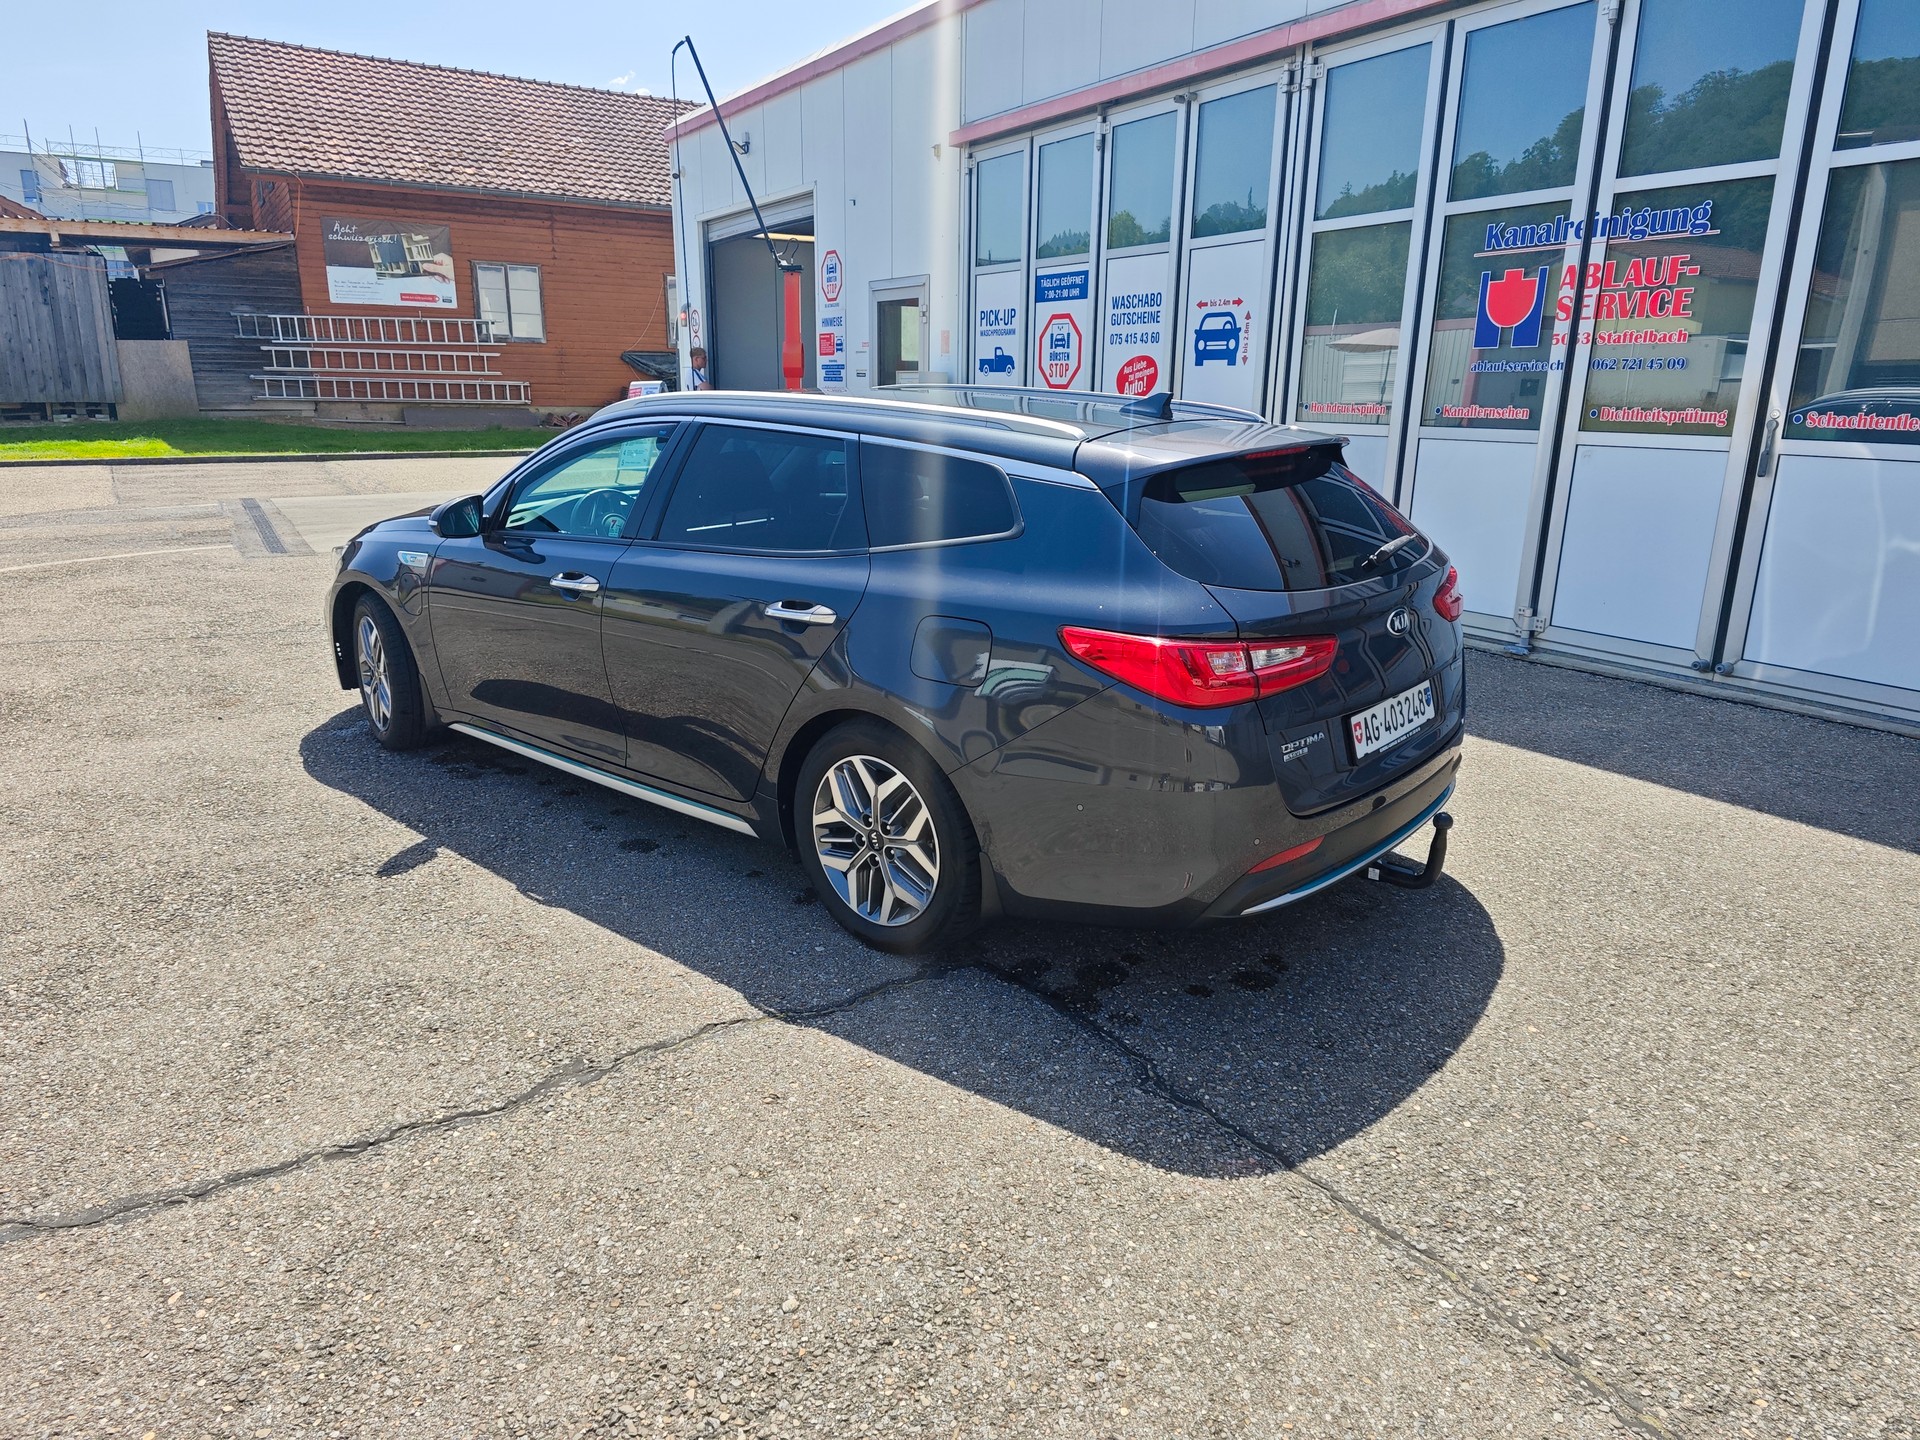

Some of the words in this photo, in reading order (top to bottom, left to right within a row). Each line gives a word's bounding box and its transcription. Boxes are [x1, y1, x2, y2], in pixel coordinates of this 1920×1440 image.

[333, 220, 358, 233] Ächt
[1485, 200, 1713, 250] Kanalreinigung
[1560, 254, 1700, 290] ABLAUF-
[826, 283, 837, 294] STOP
[1040, 277, 1060, 287] TÄGLICH
[1060, 275, 1085, 286] GEÖFFNET
[1044, 289, 1068, 299] 7:00-21:00
[1069, 288, 1080, 297] UHR
[1111, 292, 1162, 310] WASCHABO
[1209, 299, 1218, 307] bis
[1555, 288, 1694, 322] SERVICE
[821, 316, 843, 328] HINWEISE
[980, 308, 1016, 327] PICK-UP
[1111, 311, 1161, 326] GUTSCHEINE
[980, 328, 1016, 337] WASCHPROGRAMM
[1110, 333, 1123, 345] 075
[1124, 332, 1138, 345] 415
[1139, 332, 1149, 344] 43
[1150, 332, 1160, 344] 60
[1596, 328, 1689, 345] Staffelbach
[1049, 350, 1070, 362] BÜRSTEN
[1049, 363, 1070, 378] STOP
[1123, 366, 1133, 375] Aus
[1133, 360, 1147, 371] Liebe
[1591, 358, 1617, 371] 062
[1621, 358, 1643, 371] 721
[1646, 358, 1663, 370] 45
[1667, 357, 1687, 370] 09
[1135, 367, 1155, 379] meinem
[1123, 376, 1147, 395] Auto!
[1310, 402, 1386, 417] Hochdruckspülen
[1442, 404, 1530, 420] Kanalfernsehen
[1599, 406, 1728, 427] Dichtheitsprüfung
[1805, 410, 1920, 432] Schachtentle
[1392, 612, 1409, 631] KIA
[1281, 732, 1325, 753] OPTIMA
